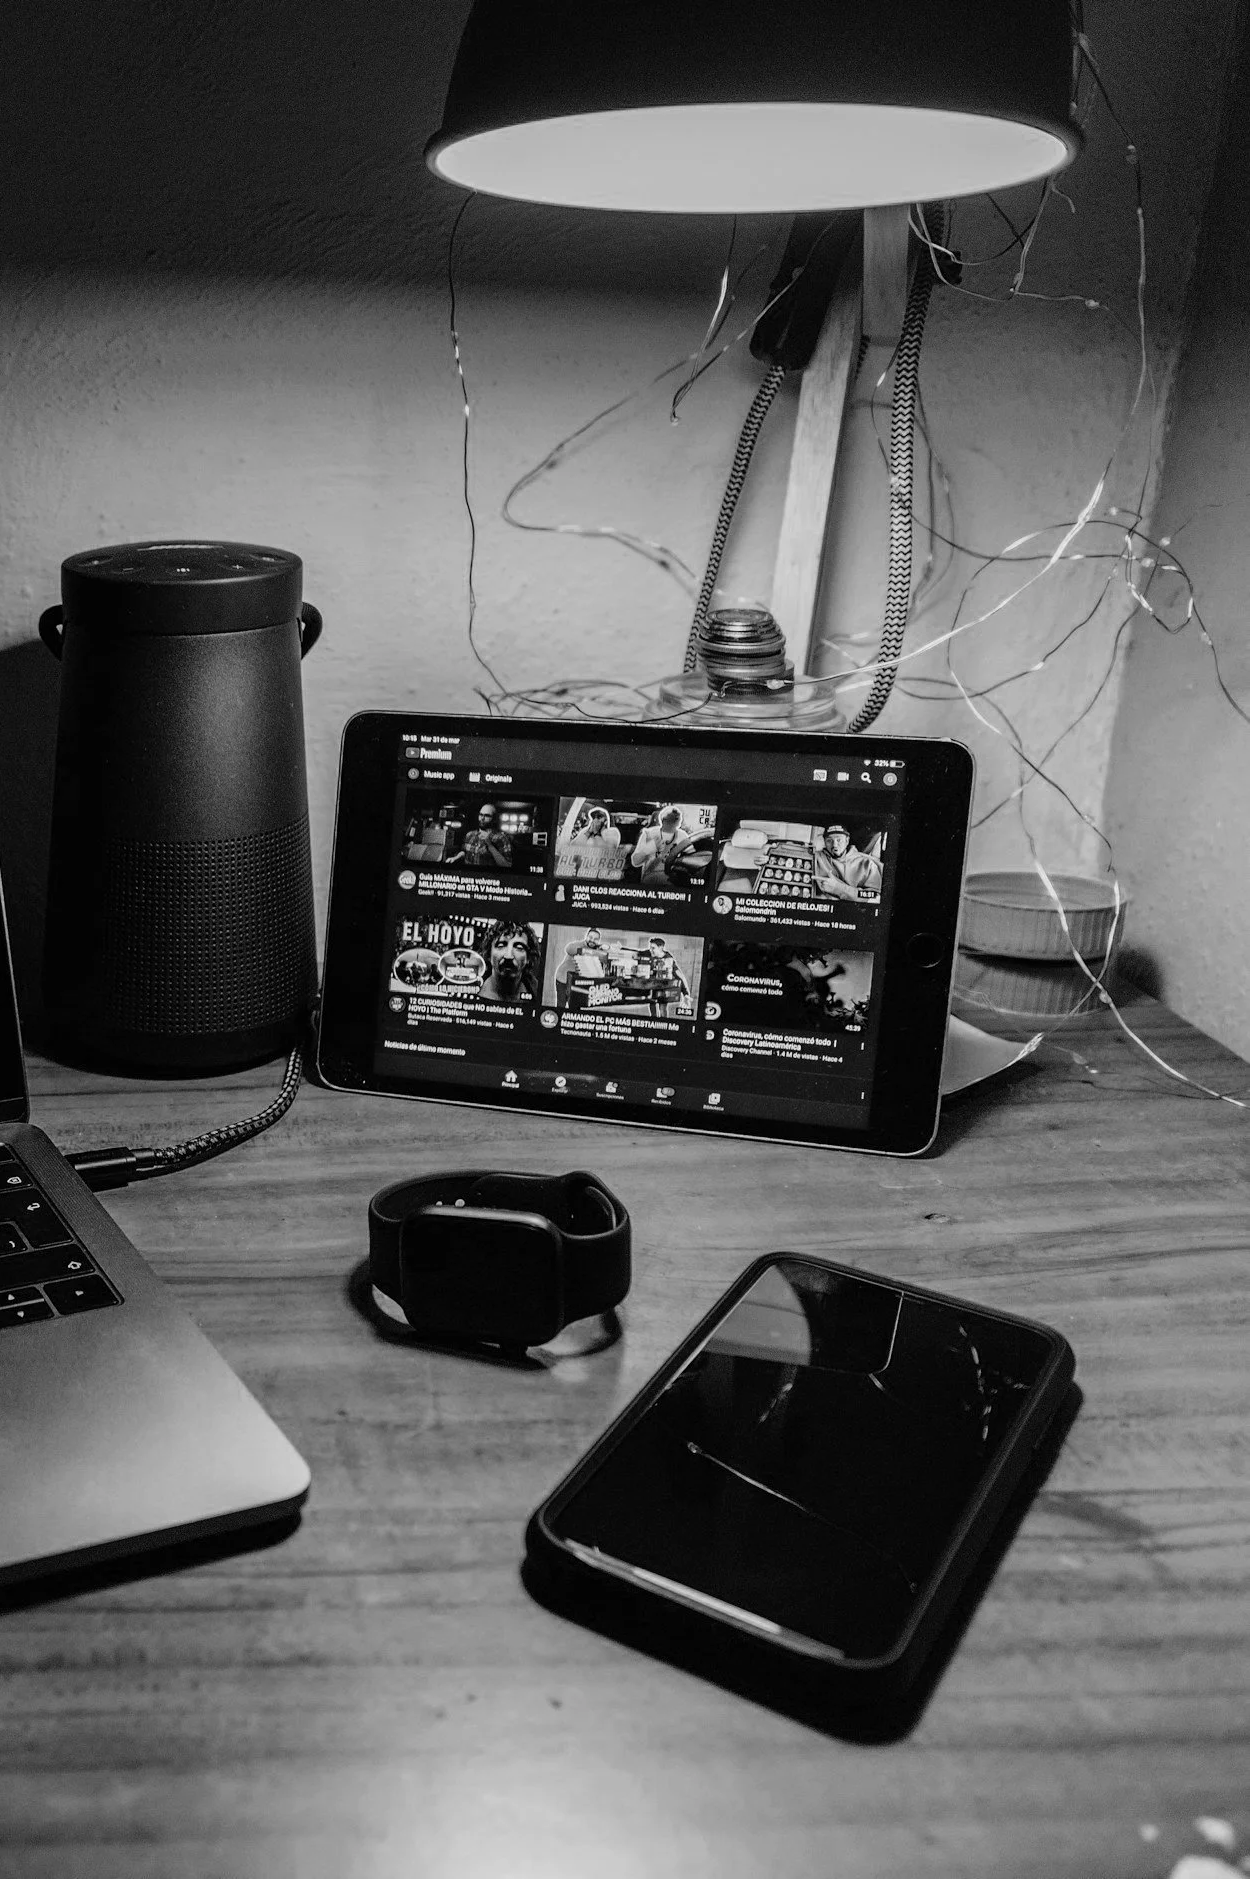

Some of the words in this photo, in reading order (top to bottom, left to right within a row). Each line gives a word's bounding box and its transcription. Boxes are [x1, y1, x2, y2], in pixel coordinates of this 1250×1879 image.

[420, 747, 452, 760] Premium
[424, 770, 442, 778] Music
[485, 774, 512, 783] Originals
[434, 873, 460, 883] MÁXIMA
[475, 878, 500, 886] volverse
[590, 886, 608, 894] CLOS
[609, 888, 647, 897] REACCIONA
[403, 922, 422, 942] EL
[427, 923, 475, 946] HOYO
[727, 973, 782, 988] CORONAVIRUS,
[721, 984, 739, 992] cómo
[740, 986, 767, 994] comenzó
[768, 988, 783, 996] todo
[575, 1023, 595, 1031] gastar
[609, 1025, 631, 1033] fortuna
[722, 1036, 754, 1046] Discovery
[755, 1040, 801, 1051] Latinoamérica
[723, 1028, 763, 1040] Coronavirus,
[784, 1035, 814, 1045] comenzó
[816, 1038, 831, 1046] todo
[384, 1040, 408, 1050] Noticias
[410, 1042, 417, 1050] de
[418, 1044, 436, 1052] último
[437, 1046, 466, 1056] momento
